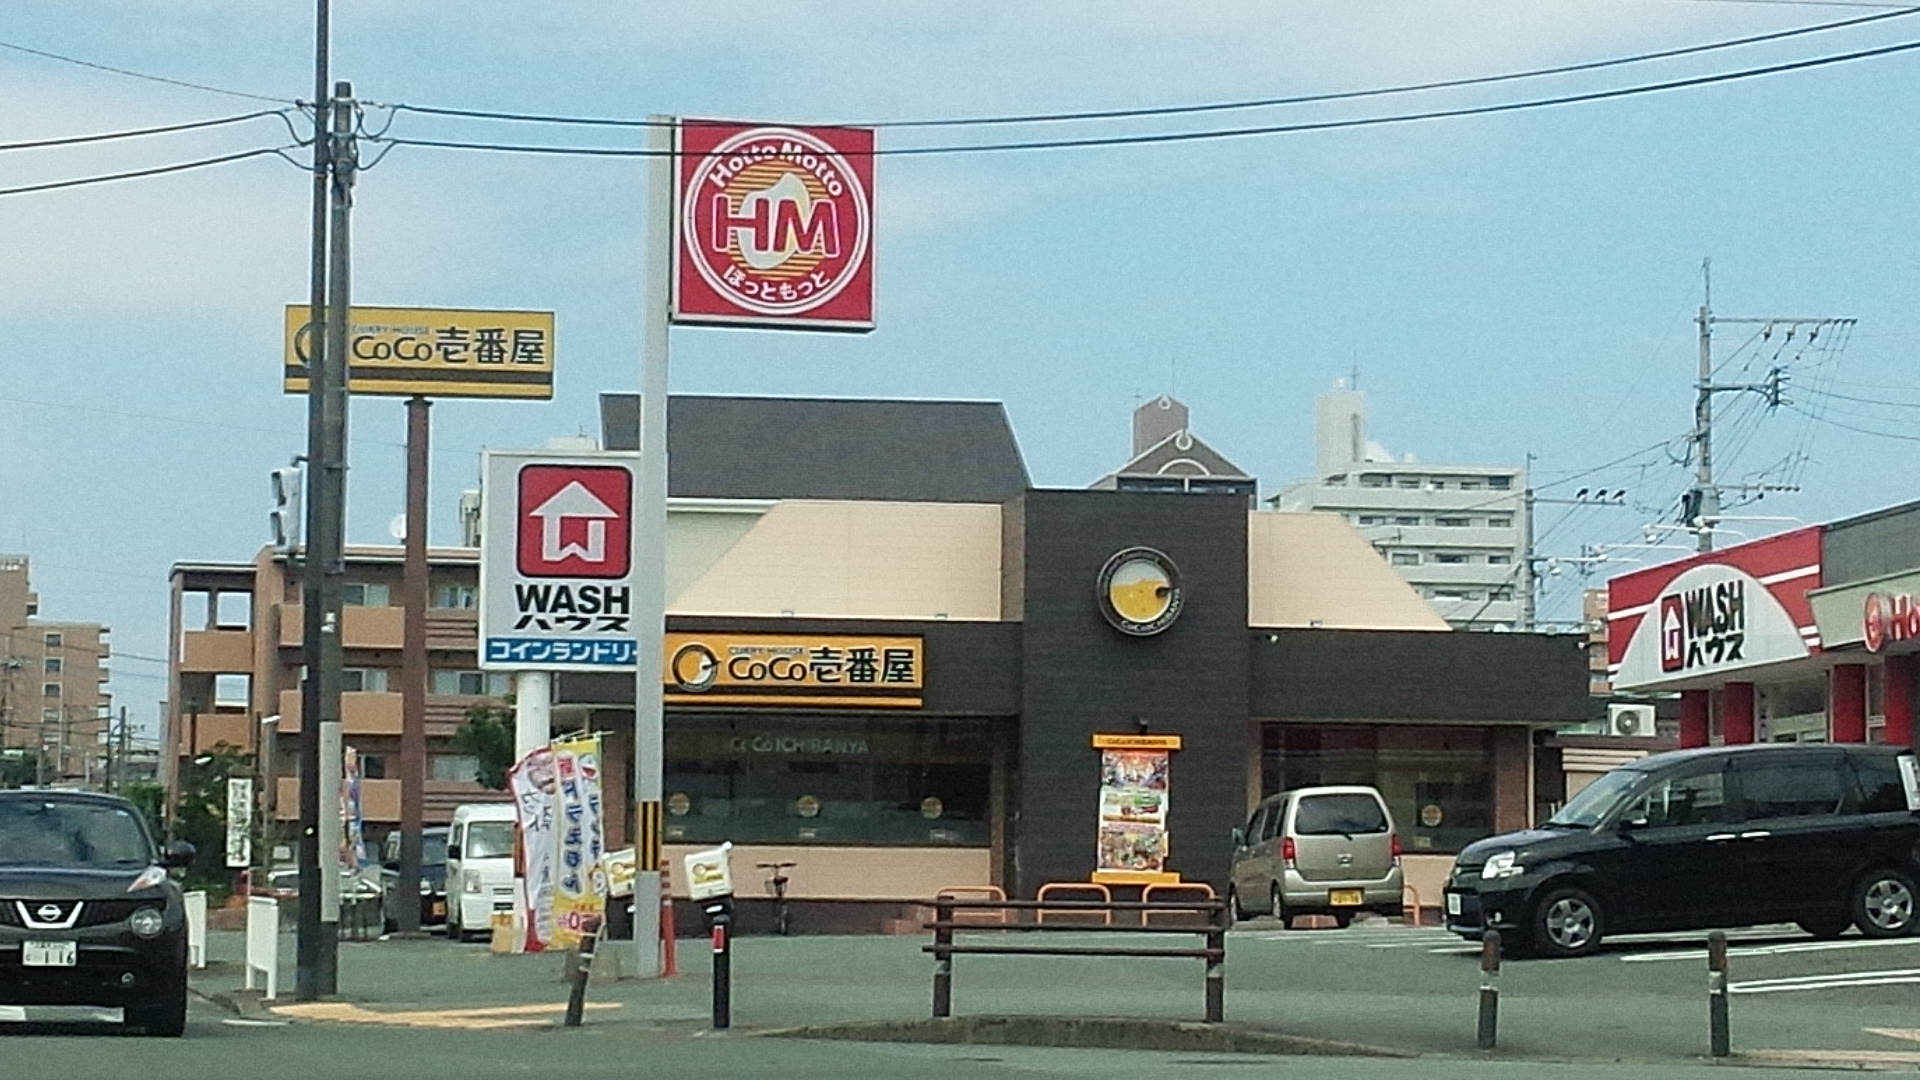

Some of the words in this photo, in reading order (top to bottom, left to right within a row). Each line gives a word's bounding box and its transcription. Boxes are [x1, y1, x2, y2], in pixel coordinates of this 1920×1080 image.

[709, 144, 777, 187] Hotto
[780, 142, 843, 196] Motto
[713, 193, 840, 258] HM
[724, 265, 830, 301] ほっともっと
[515, 584, 630, 614] WASH
[1686, 579, 1745, 639] WASH
[513, 615, 630, 632] ハウス
[491, 641, 637, 662] コインランドリ
[1686, 633, 1745, 668] ハウス
